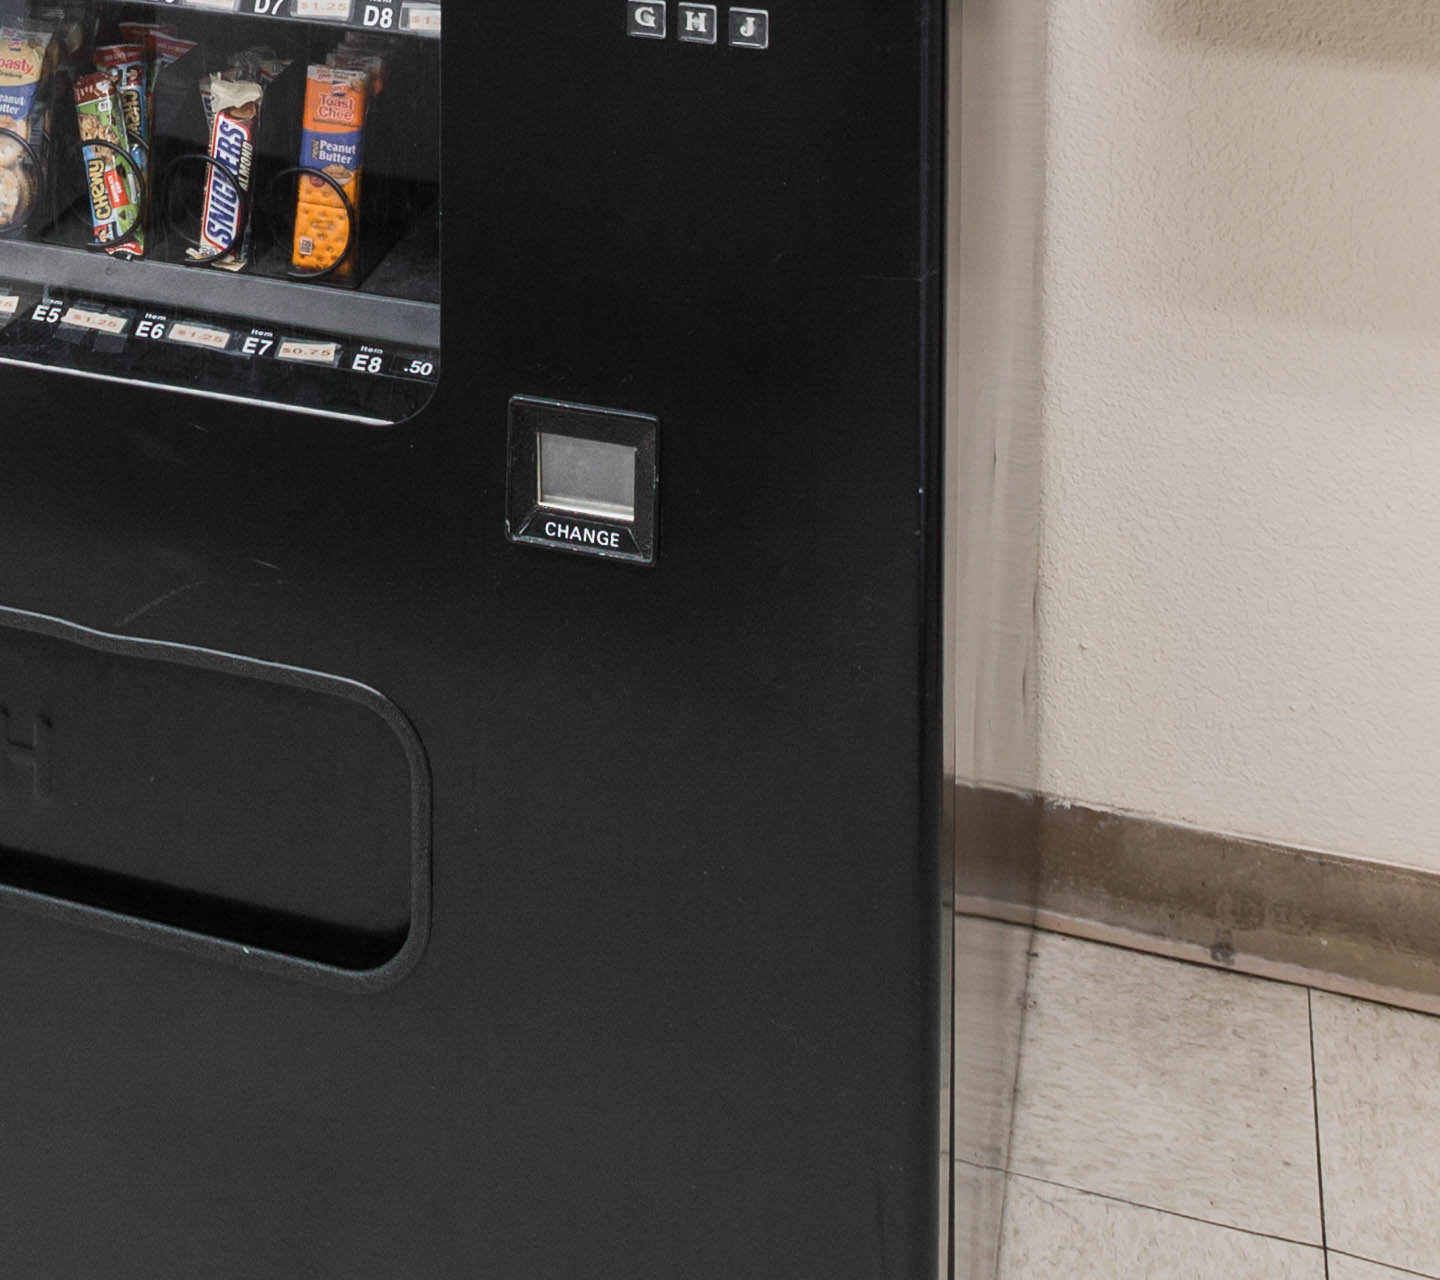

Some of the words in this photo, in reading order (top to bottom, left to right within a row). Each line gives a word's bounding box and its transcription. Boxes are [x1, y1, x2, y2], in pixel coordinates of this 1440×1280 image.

[319, 95, 353, 110] Toast
[320, 140, 357, 156] Peanut
[239, 141, 254, 191] ALMOND
[319, 151, 353, 165] Butter
[206, 121, 249, 248] SNICKERS
[135, 321, 165, 339] E6
[242, 336, 273, 355] E7
[352, 354, 383, 373] E8
[403, 359, 433, 377] .50
[546, 522, 619, 547] CHANGE
